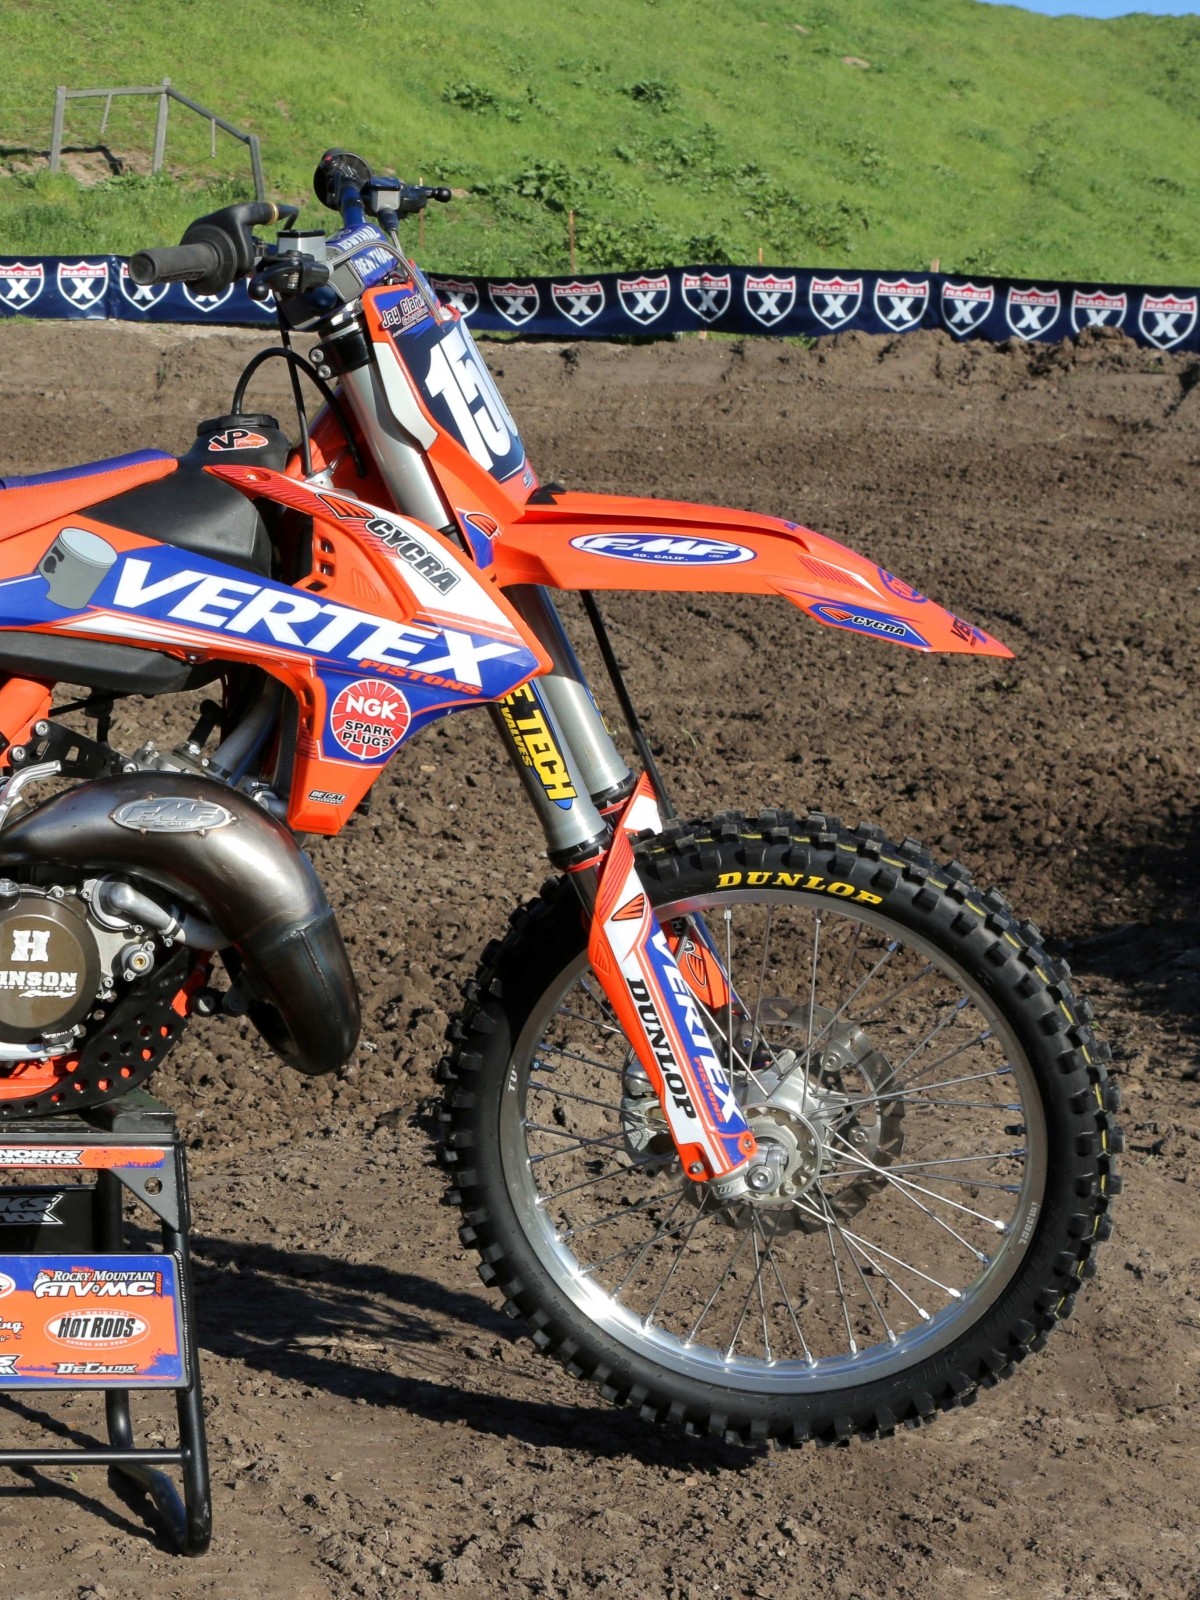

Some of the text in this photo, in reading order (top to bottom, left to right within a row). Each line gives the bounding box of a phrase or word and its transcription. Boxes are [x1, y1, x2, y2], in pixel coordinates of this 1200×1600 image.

[6, 278, 31, 300] X
[71, 277, 96, 299] X
[434, 283, 475, 293] RACER
[492, 287, 533, 295] RACER
[556, 287, 599, 295] RACER
[621, 282, 665, 290] RACER
[686, 280, 726, 288] RACER
[749, 281, 792, 290] RACER
[813, 284, 858, 292] RACER
[879, 286, 924, 295] RACER
[945, 290, 989, 299] RACER
[503, 296, 529, 315] X
[566, 296, 594, 315] X
[632, 292, 657, 314] X
[697, 289, 719, 312] X
[756, 292, 782, 315] X
[821, 294, 848, 318] X
[886, 296, 914, 321] X
[1011, 295, 1056, 304] RACER
[1077, 298, 1122, 308] RACER
[1146, 302, 1191, 311] RACER
[950, 300, 978, 324] X
[1016, 305, 1046, 329] X
[1150, 312, 1181, 338] X
[366, 518, 460, 595] CYCRA
[581, 537, 739, 557] FMF
[112, 557, 522, 688] VERTEX
[851, 615, 906, 637] CYCRA
[358, 659, 483, 696] PISTONS
[345, 695, 399, 721] NGK
[343, 732, 389, 747] PLUGS
[345, 721, 392, 737] SPARK
[501, 707, 533, 767] VALVES
[517, 709, 578, 800] TECH
[715, 871, 883, 905] DUNLOP
[10, 929, 50, 962] H
[651, 929, 746, 1126] VERTEX
[626, 977, 697, 1120] DUNLOP
[53, 1271, 155, 1281] ROCKY MOUNTAIN
[57, 1317, 136, 1338] HOT RODS
